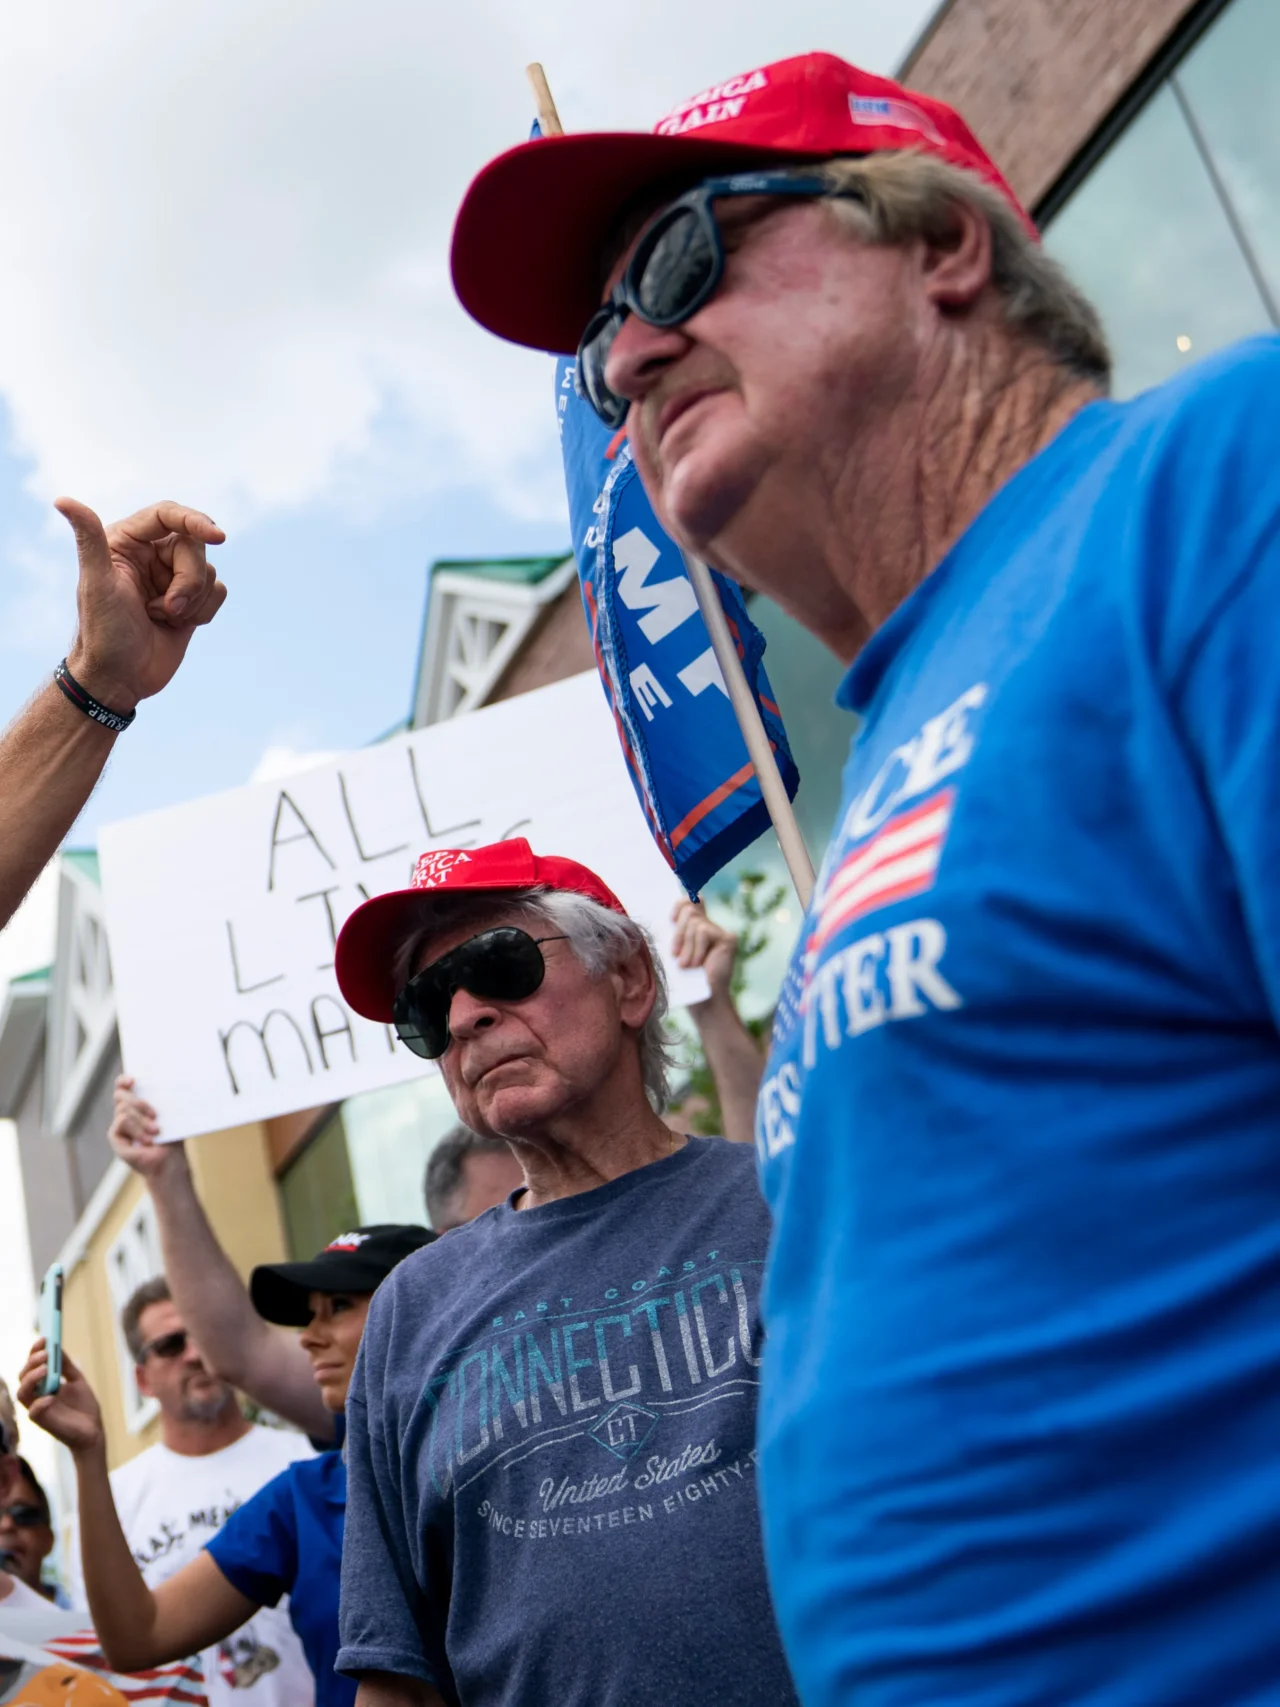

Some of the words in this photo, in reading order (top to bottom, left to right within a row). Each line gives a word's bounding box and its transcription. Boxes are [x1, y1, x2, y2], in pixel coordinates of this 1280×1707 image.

[654, 96, 748, 136] GAIN
[88, 709, 125, 731] RUMP
[267, 745, 482, 893] ALL
[803, 917, 963, 1070] TTER
[218, 993, 397, 1096] MA
[492, 1297, 573, 1328] EAST
[604, 1250, 720, 1300] COAST
[423, 1268, 763, 1499] CONNECTICU
[606, 1414, 640, 1447] CT
[538, 1462, 629, 1512] United
[633, 1438, 722, 1489] States
[477, 1500, 525, 1538] SINCE
[529, 1503, 653, 1539] SEVENTEEN
